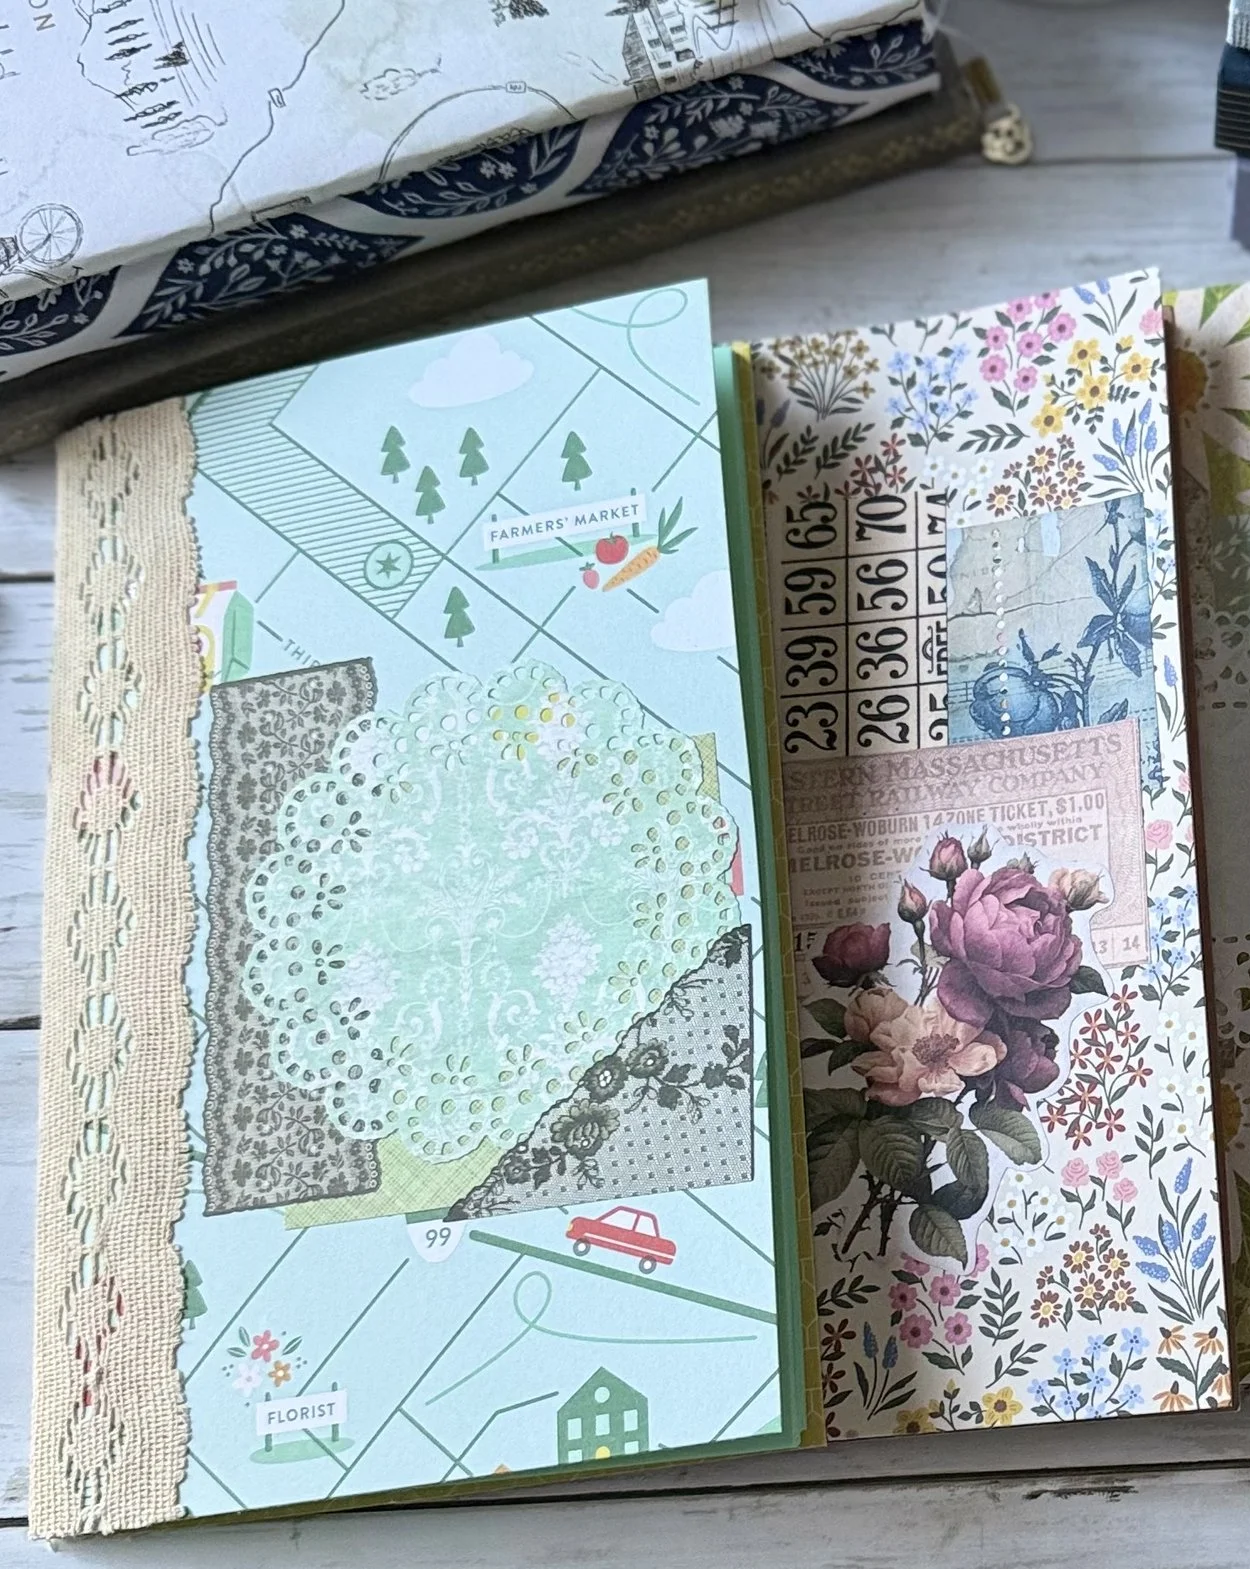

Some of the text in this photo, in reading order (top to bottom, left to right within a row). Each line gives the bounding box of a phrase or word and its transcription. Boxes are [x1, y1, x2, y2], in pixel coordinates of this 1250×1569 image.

[490, 504, 639, 542] FARMERS' MARKET
[784, 501, 838, 753] 23 39 59 65
[855, 494, 910, 748] 26 36 56 70
[886, 733, 1122, 781] MASSACHUSETTS
[988, 762, 1106, 794] COMPANY
[989, 800, 1054, 822] TICKET,
[1055, 792, 1105, 815] $1.00
[1003, 824, 1103, 847] DISTRICT
[1122, 935, 1141, 951] 14
[425, 1227, 452, 1249] 99
[267, 1402, 337, 1425] FLORIST
